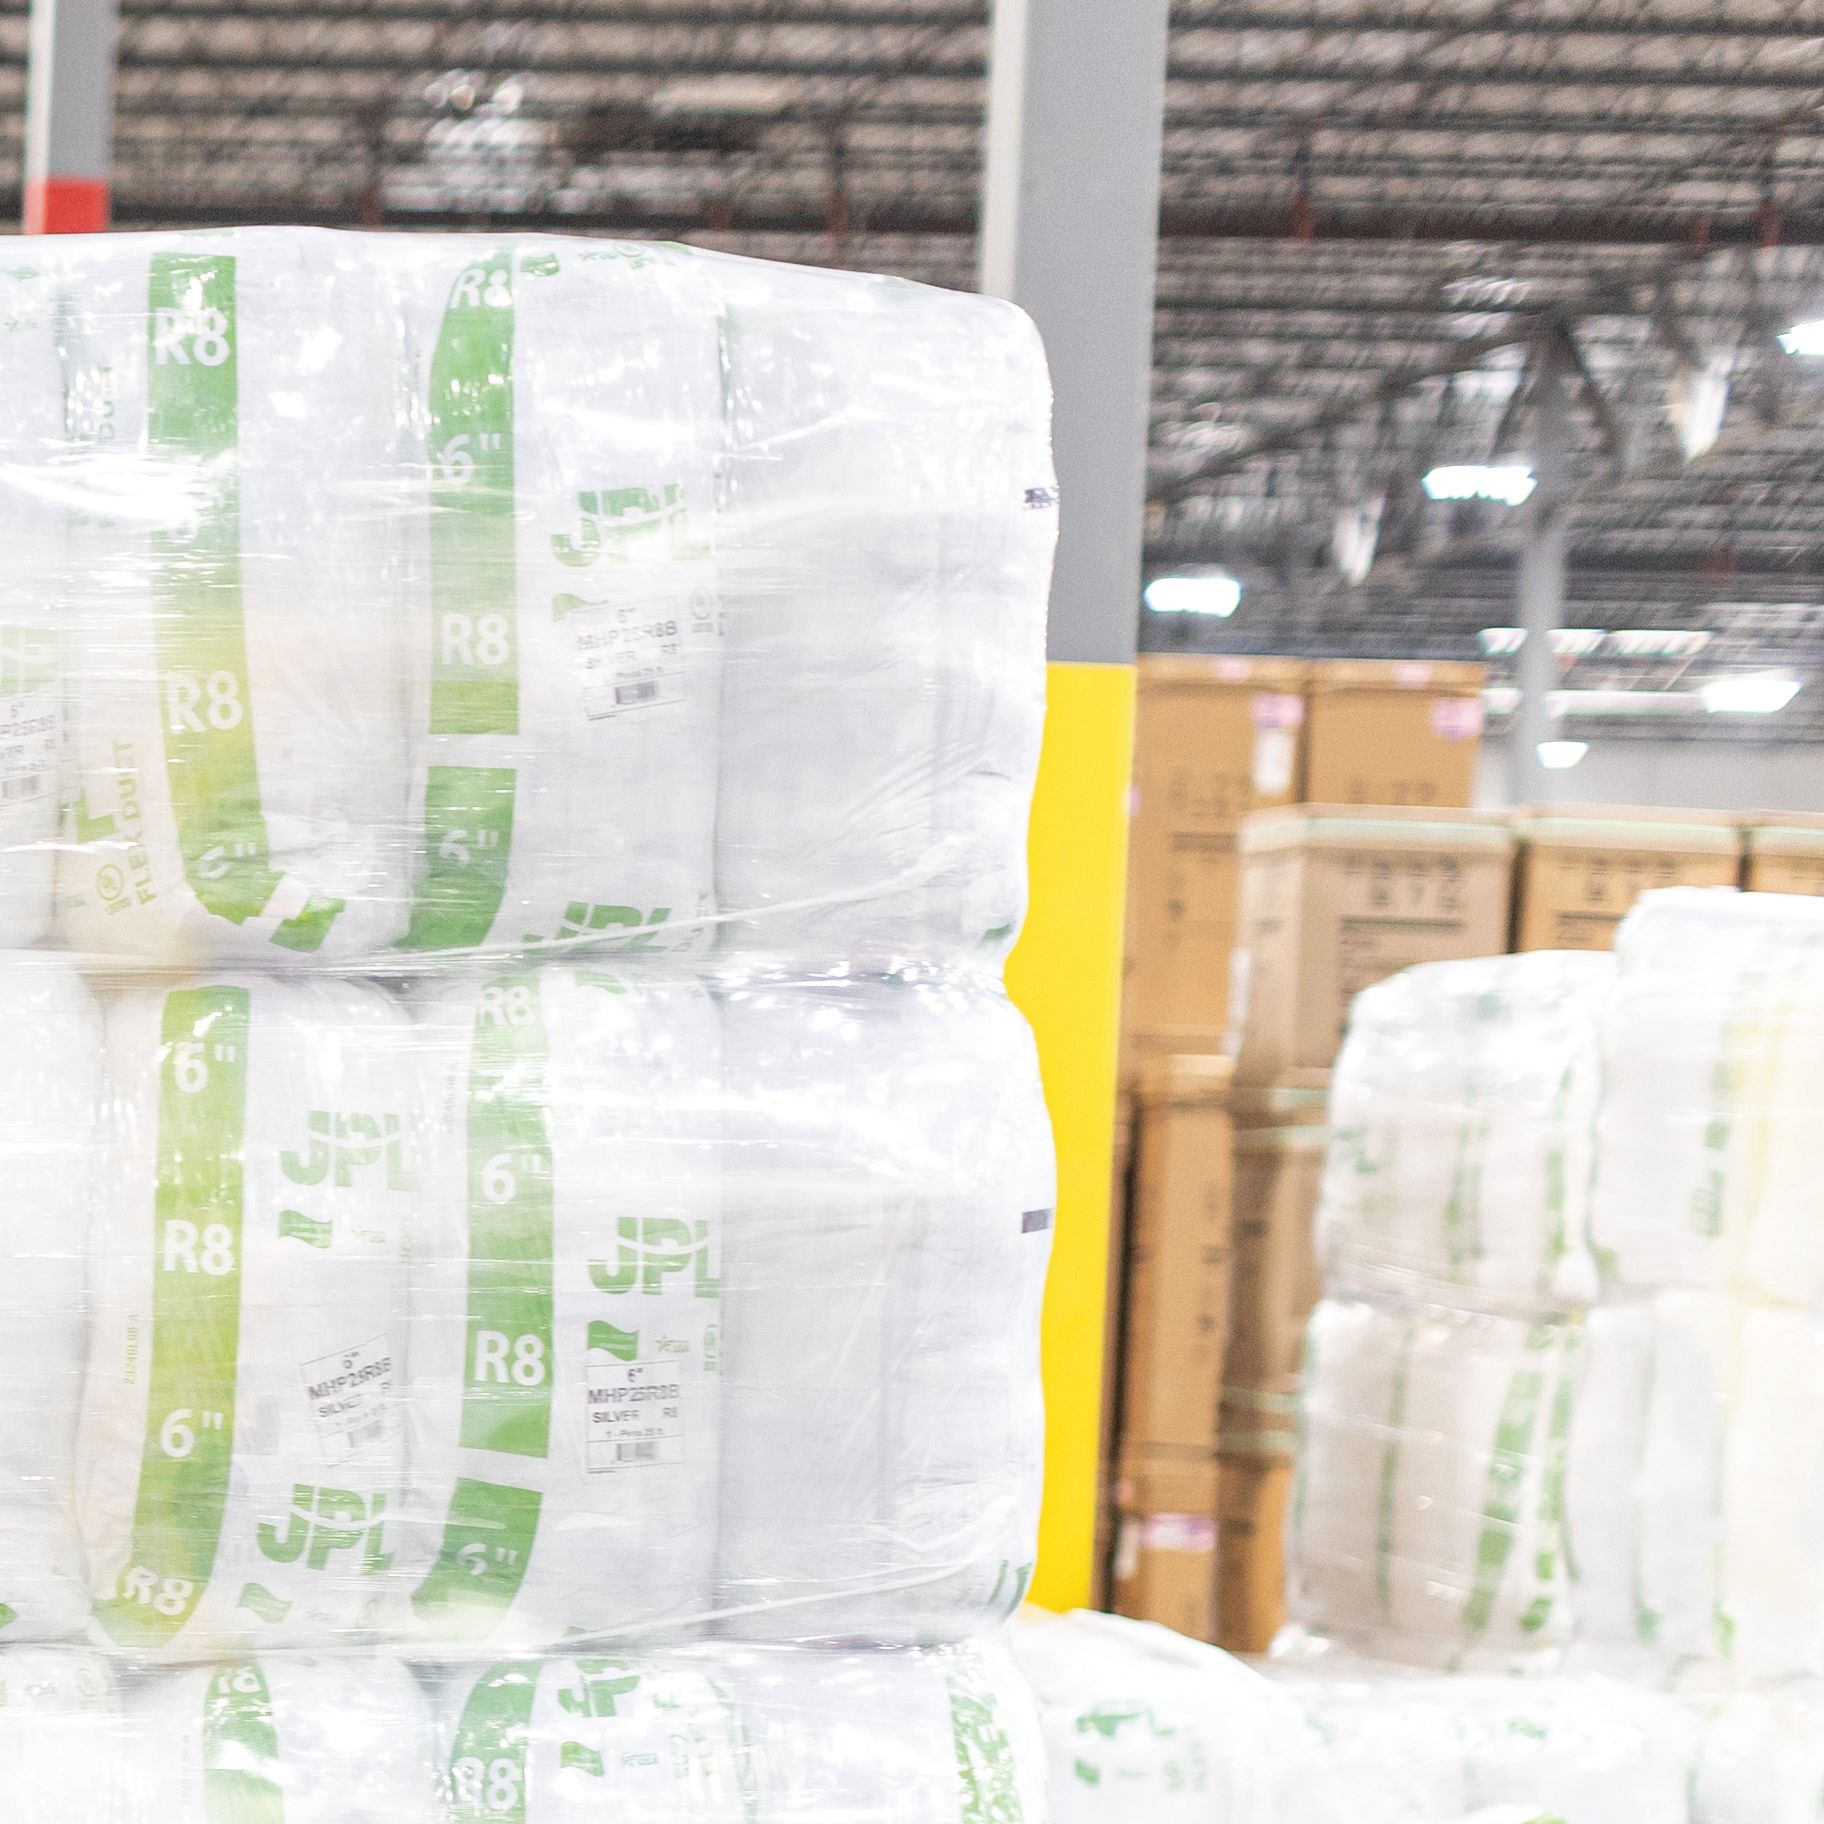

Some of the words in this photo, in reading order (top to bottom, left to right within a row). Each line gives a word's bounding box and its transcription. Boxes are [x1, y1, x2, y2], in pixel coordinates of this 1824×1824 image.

[154, 307, 232, 367] R8
[440, 432, 503, 487] 6"
[439, 615, 510, 668] R8
[165, 670, 245, 731] R8
[173, 1041, 237, 1096] 6"
[481, 1151, 542, 1204] 6"
[162, 1218, 236, 1278] R8
[474, 1329, 546, 1388] R8
[158, 1408, 223, 1459] 6"
[257, 1483, 396, 1577] JPL
[456, 1541, 518, 1577] 6"
[122, 1565, 194, 1618] R8
